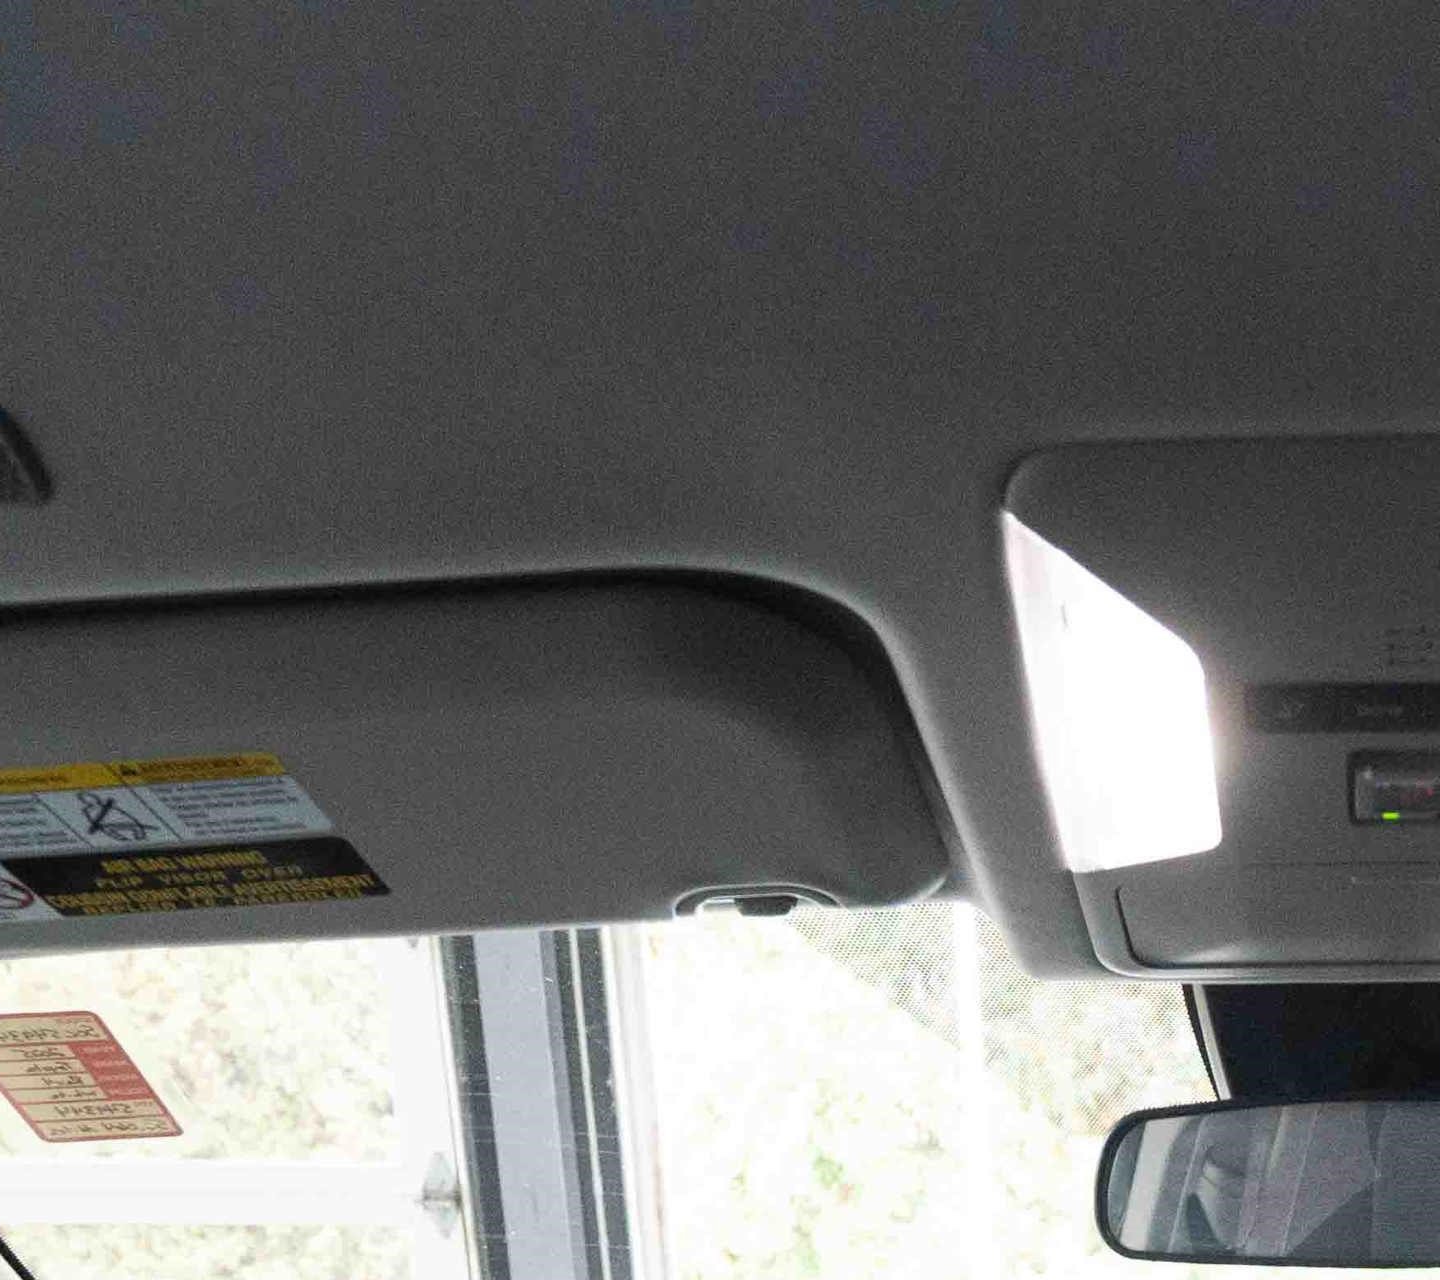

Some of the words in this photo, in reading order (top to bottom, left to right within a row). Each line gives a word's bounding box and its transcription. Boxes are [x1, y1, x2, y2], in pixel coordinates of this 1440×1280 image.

[96, 876, 143, 890] FLIP
[157, 870, 227, 886] VISOR
[241, 865, 303, 881] OVER
